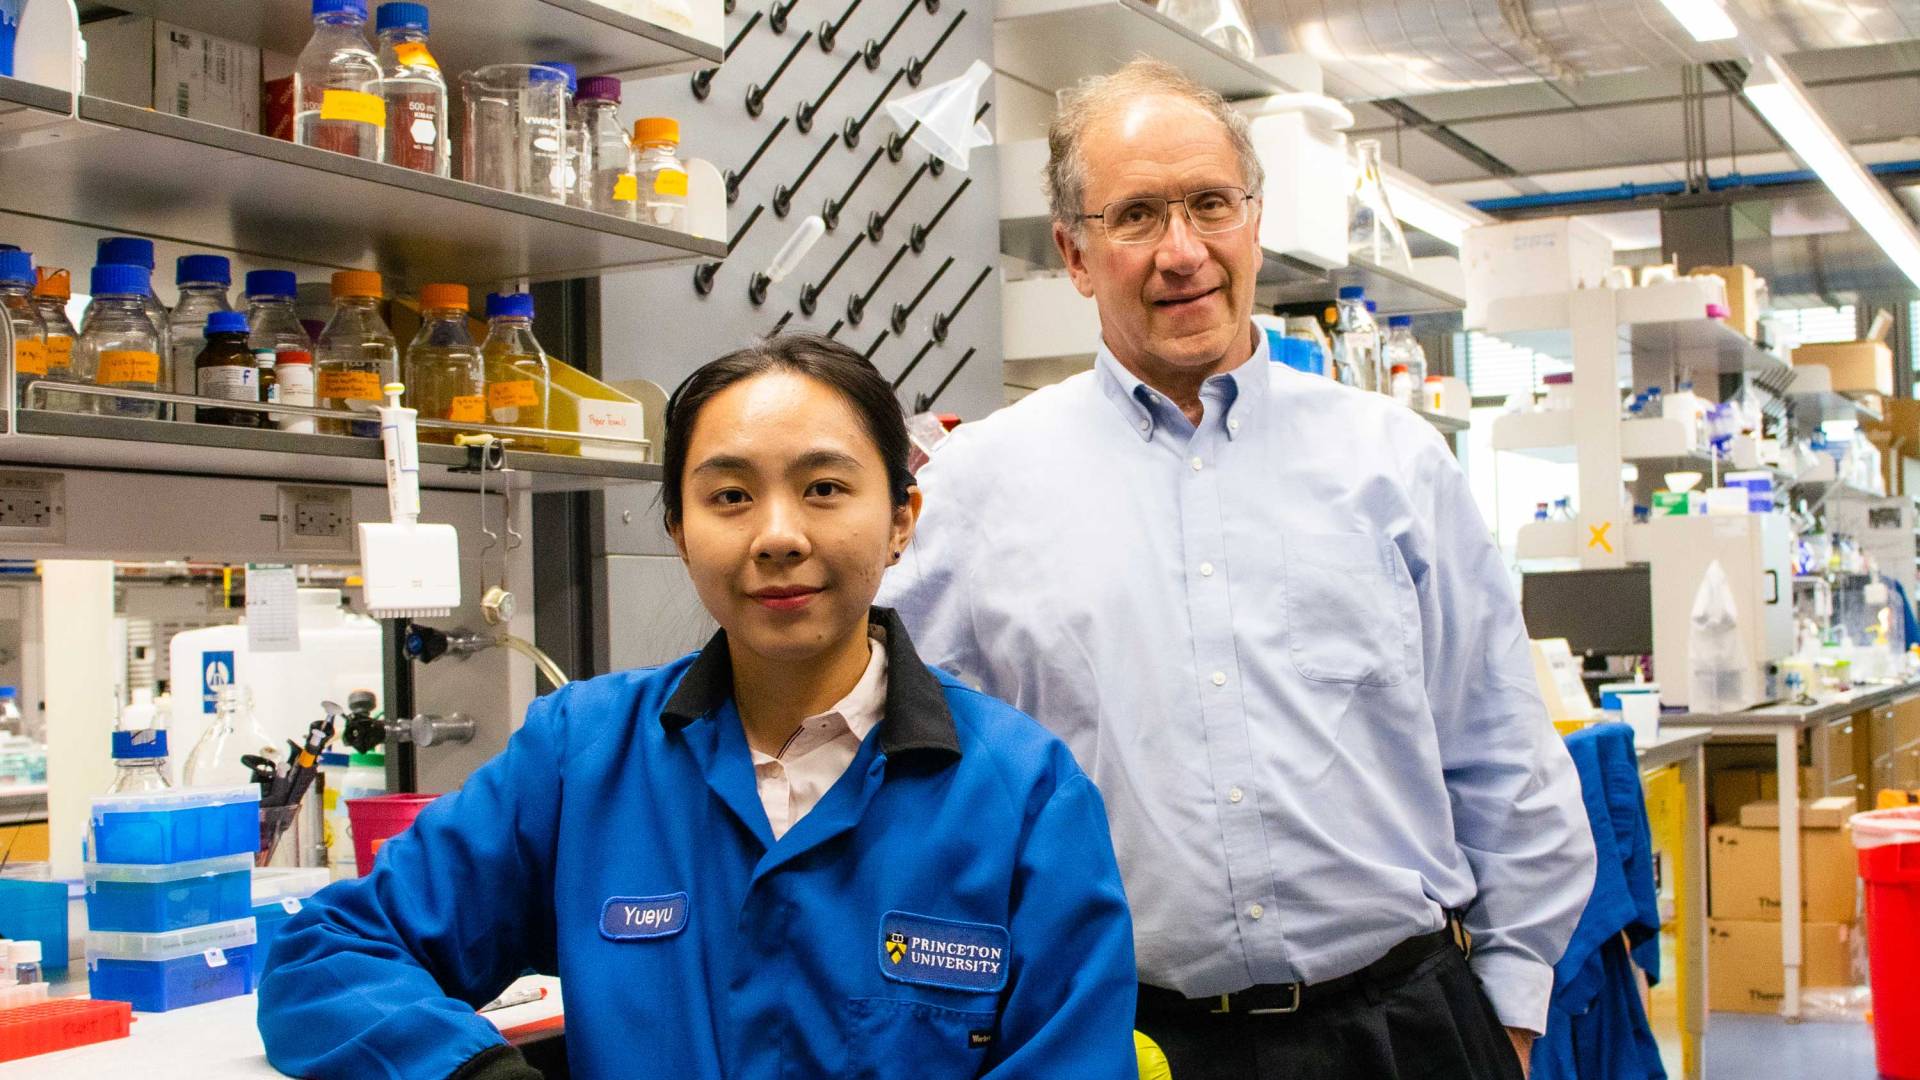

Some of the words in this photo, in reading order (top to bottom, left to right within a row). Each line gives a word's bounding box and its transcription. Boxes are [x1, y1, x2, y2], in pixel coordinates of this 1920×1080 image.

[409, 101, 425, 111] 500
[624, 905, 673, 929] Yueyu
[911, 937, 1002, 959] PRINCETON
[911, 951, 1001, 974] UNIVERSITY
